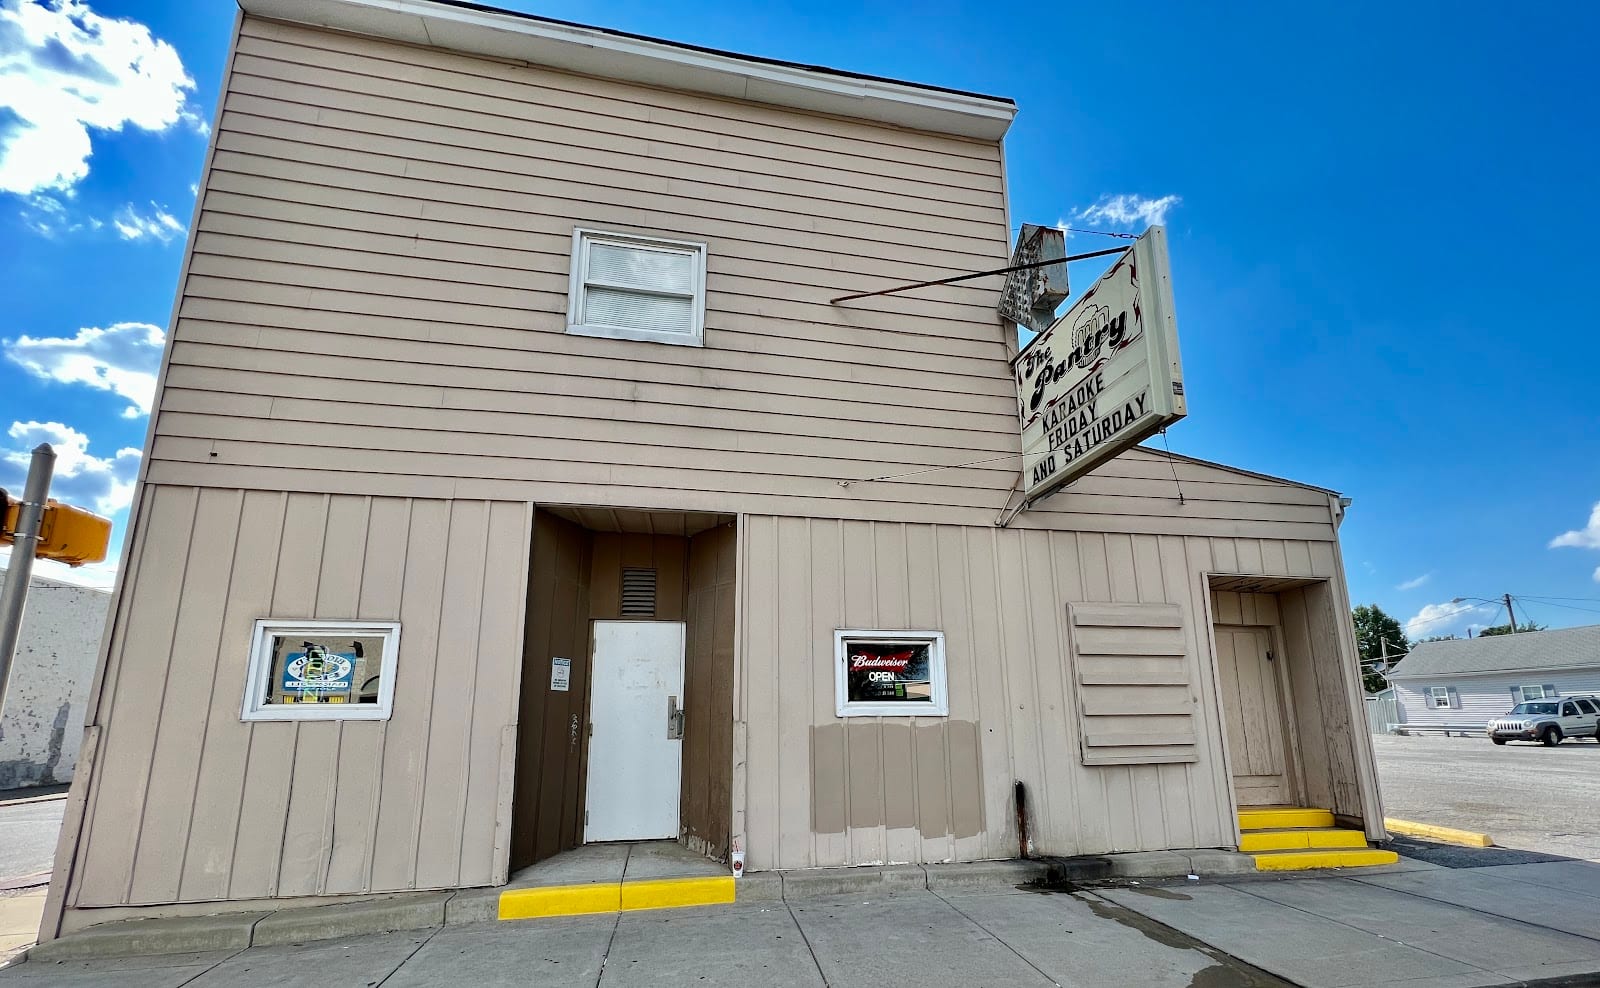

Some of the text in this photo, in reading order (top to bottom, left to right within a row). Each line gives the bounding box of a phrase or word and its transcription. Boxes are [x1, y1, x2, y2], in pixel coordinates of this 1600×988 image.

[1025, 346, 1052, 379] The
[1030, 310, 1127, 411] Pantry
[1042, 372, 1104, 435] KARAOKE
[1048, 400, 1099, 453] FRIDAY
[1032, 392, 1146, 486] AND SATURDAY
[851, 655, 908, 667] Budweiser
[868, 672, 895, 682] OPEN
